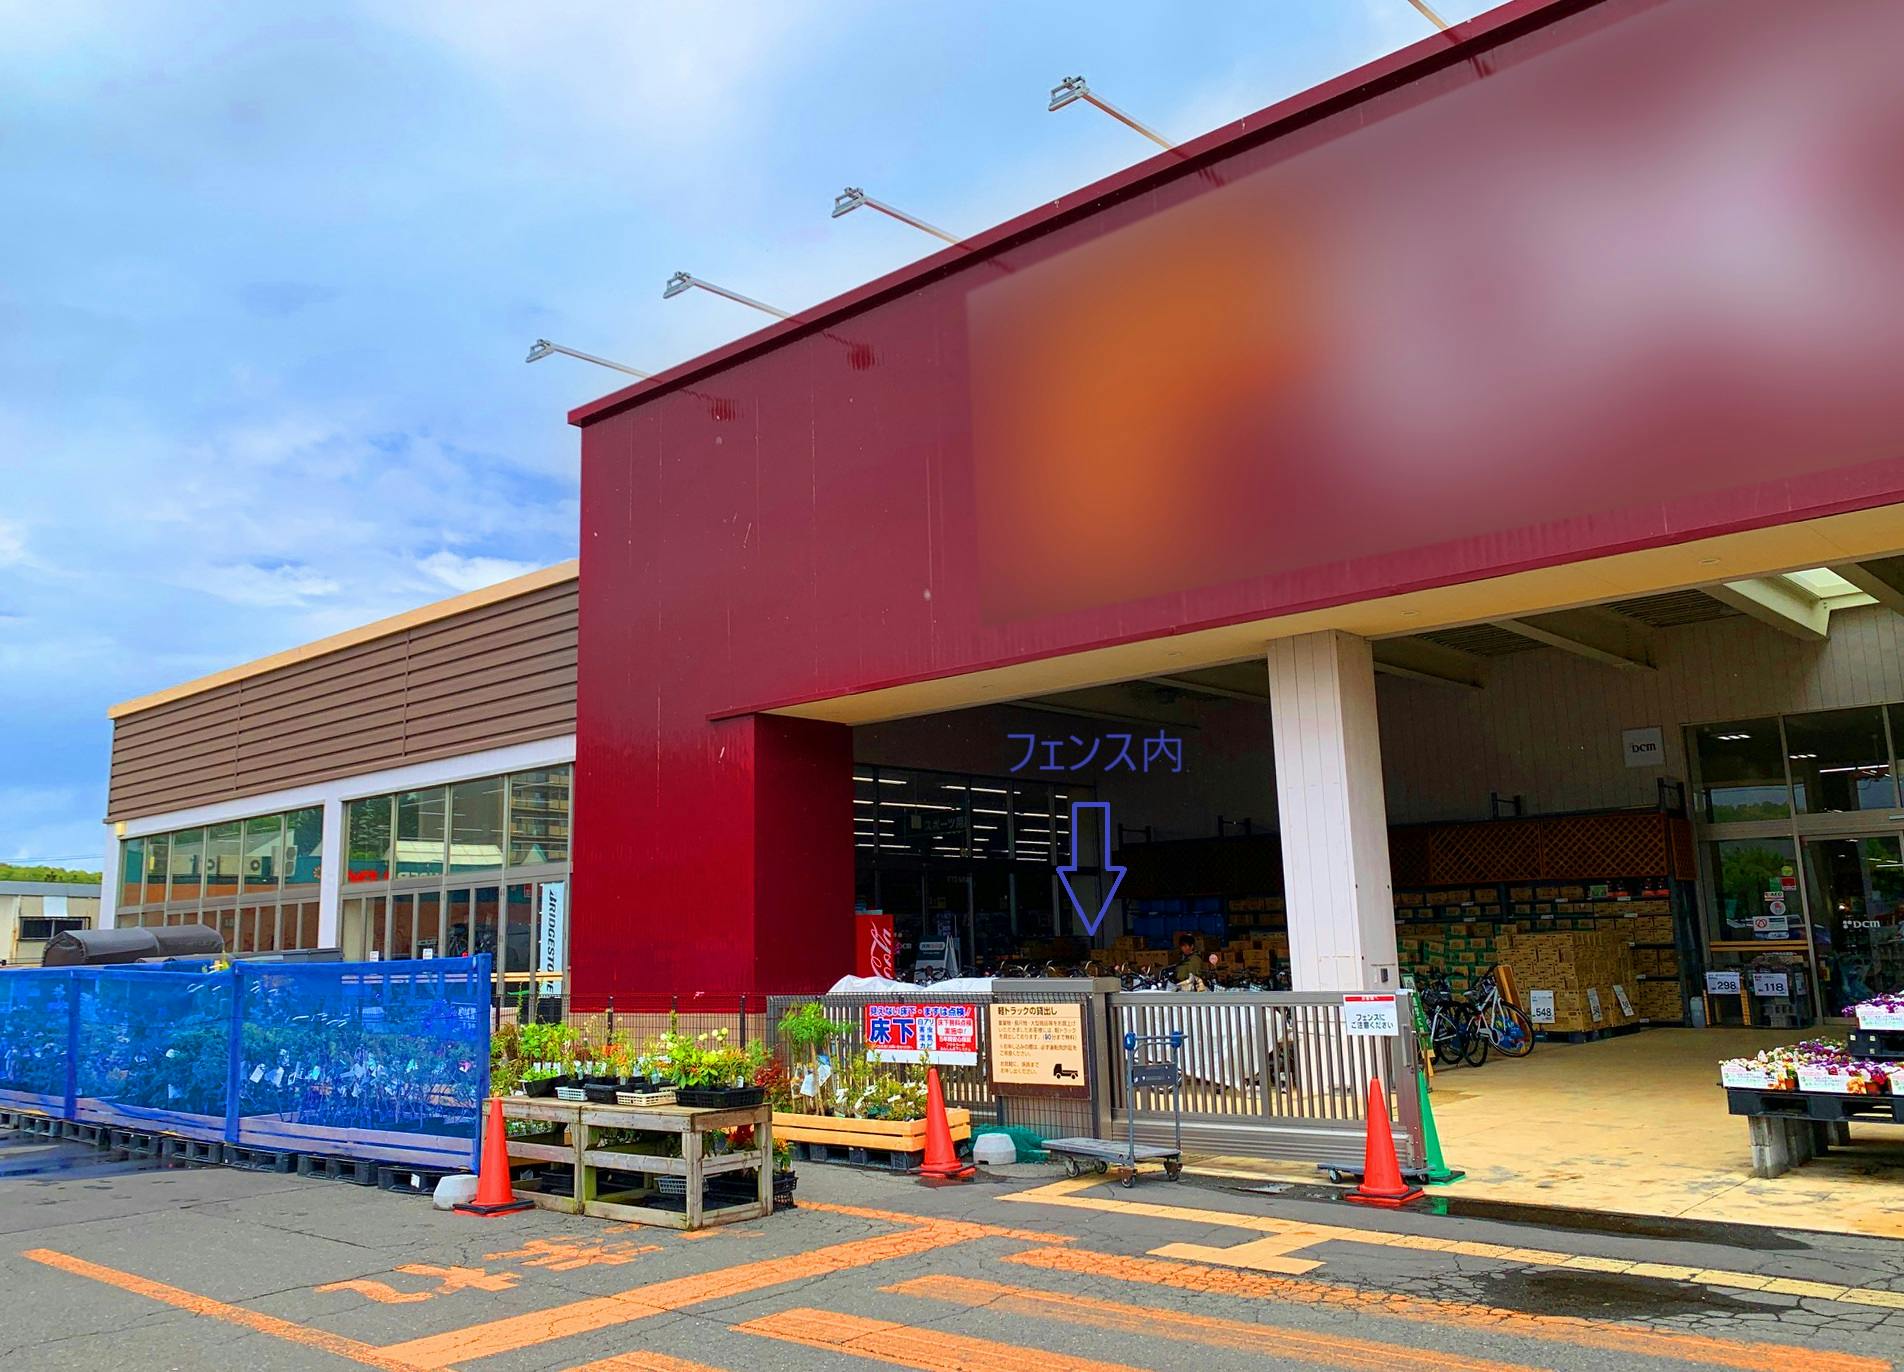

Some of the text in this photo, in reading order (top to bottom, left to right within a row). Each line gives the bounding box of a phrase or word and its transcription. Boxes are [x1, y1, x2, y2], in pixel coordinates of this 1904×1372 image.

[1853, 920, 1881, 929] DCM
[1717, 981, 1736, 990] 298
[1764, 983, 1784, 991] 118
[998, 1007, 1057, 1016] 軽トラックの貸出し
[1535, 1007, 1552, 1017] 548
[1356, 1013, 1386, 1021] フェンスに
[1351, 1021, 1394, 1030] ご注意ください
[869, 1018, 915, 1044] 床下
